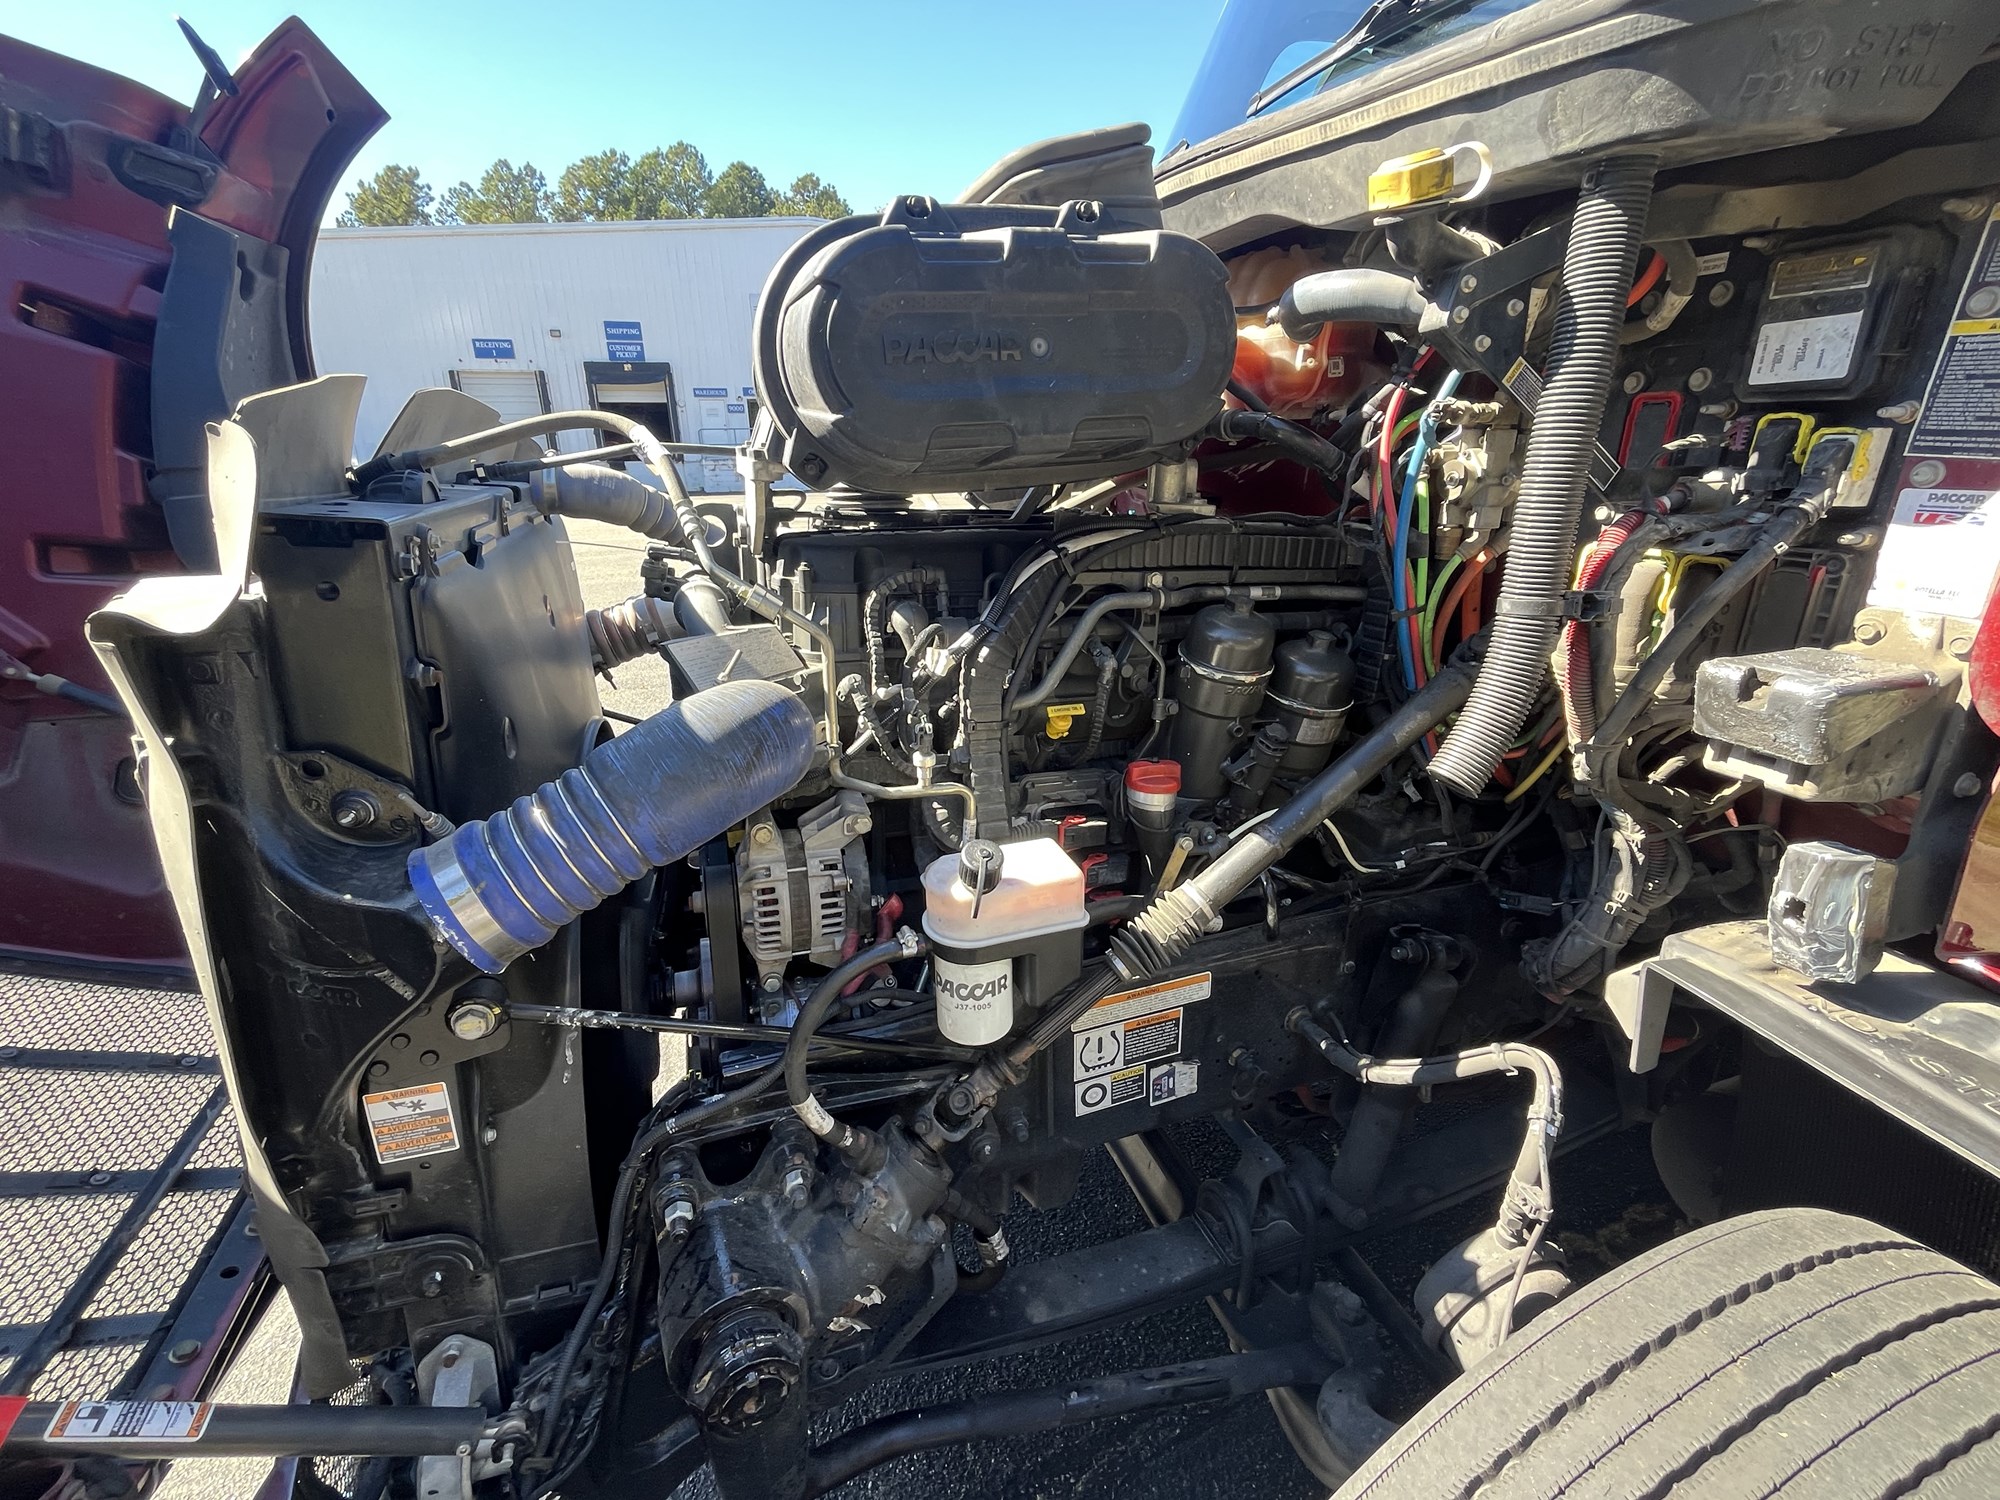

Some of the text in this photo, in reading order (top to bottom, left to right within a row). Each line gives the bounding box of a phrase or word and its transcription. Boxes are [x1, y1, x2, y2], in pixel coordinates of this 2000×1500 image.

[1806, 66, 1866, 91] NOT
[1879, 63, 1942, 91] PULL
[606, 327, 640, 335] SHIPPING
[609, 344, 642, 352] CUSTOMER
[882, 331, 1022, 365] PACCAR
[1507, 361, 1523, 384] CAUTION
[1927, 492, 1987, 504] PACCAR
[935, 971, 1008, 1002] PACCAR
[1132, 987, 1160, 998] WARNING
[954, 1002, 992, 1011] J37-1005
[1141, 1015, 1170, 1025] WARNING
[1117, 1068, 1144, 1079] CAUTION
[390, 1087, 430, 1099] WARNING
[387, 1117, 449, 1132] AVERTISSEMENT
[395, 1134, 449, 1148] ADVERTENCIA
